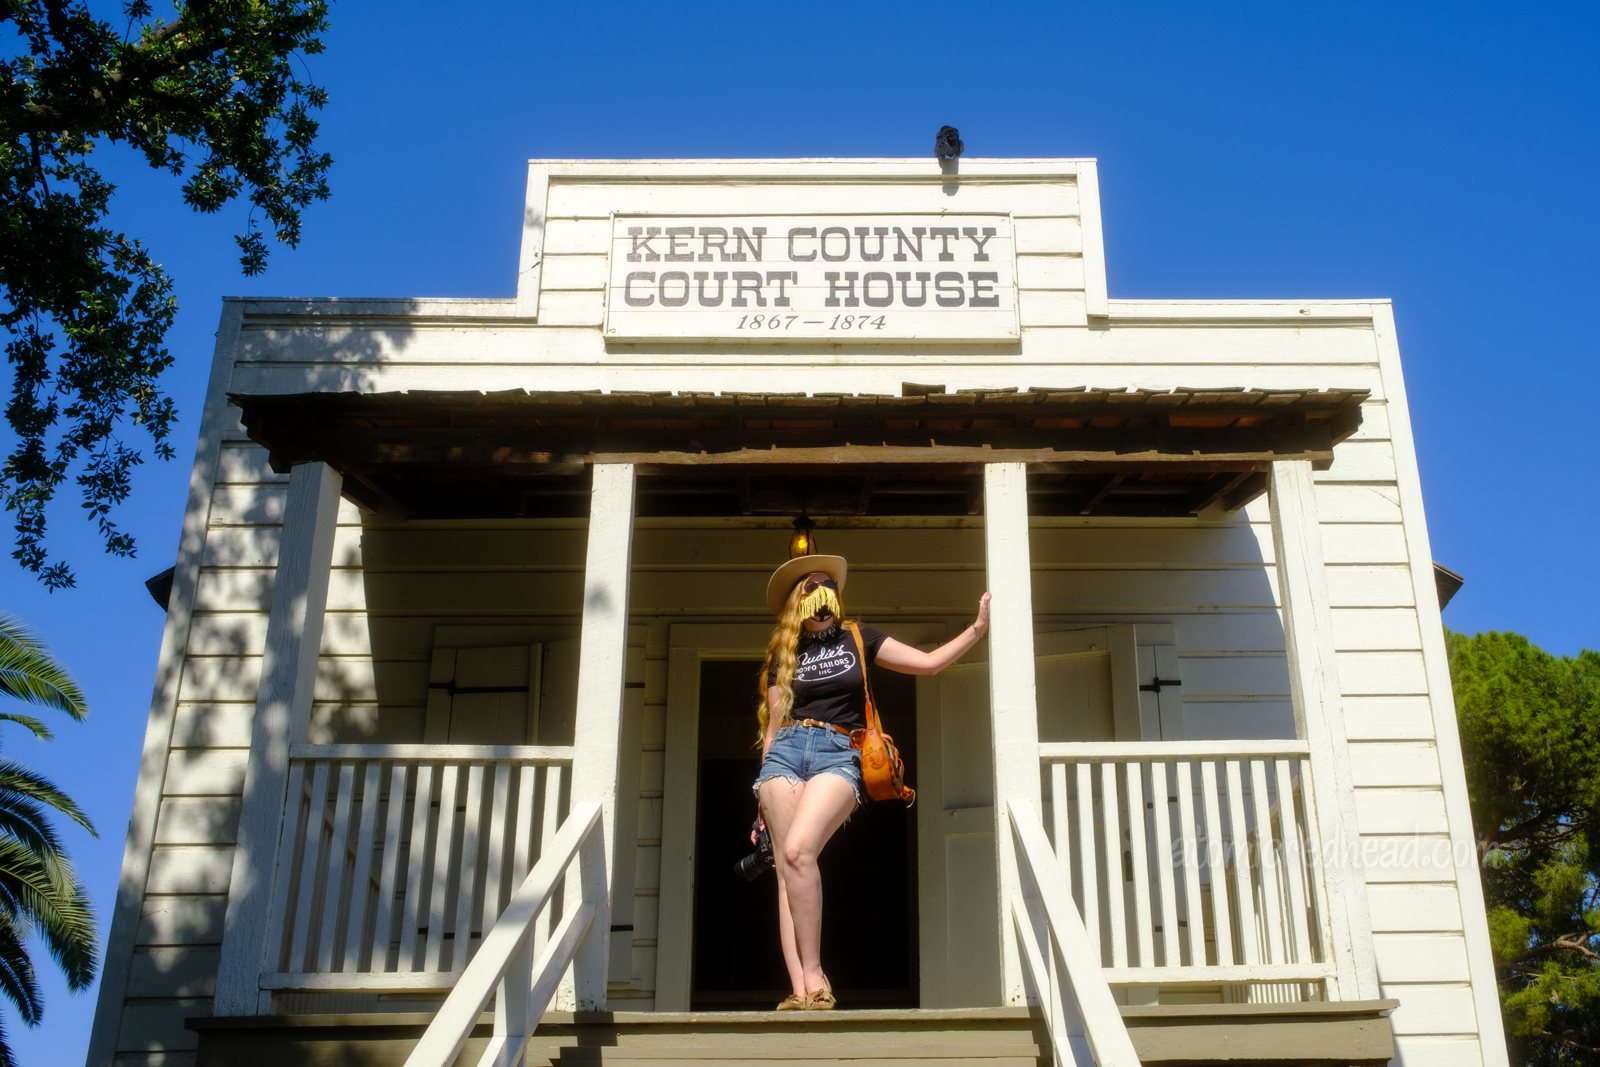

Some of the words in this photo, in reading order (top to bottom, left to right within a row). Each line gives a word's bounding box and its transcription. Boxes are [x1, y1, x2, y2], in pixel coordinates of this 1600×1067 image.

[626, 226, 768, 263] KERN
[787, 226, 998, 262] COUNTY
[624, 271, 798, 307] COURT
[824, 271, 1000, 308] HOUSE
[819, 658, 849, 669] TAILORS
